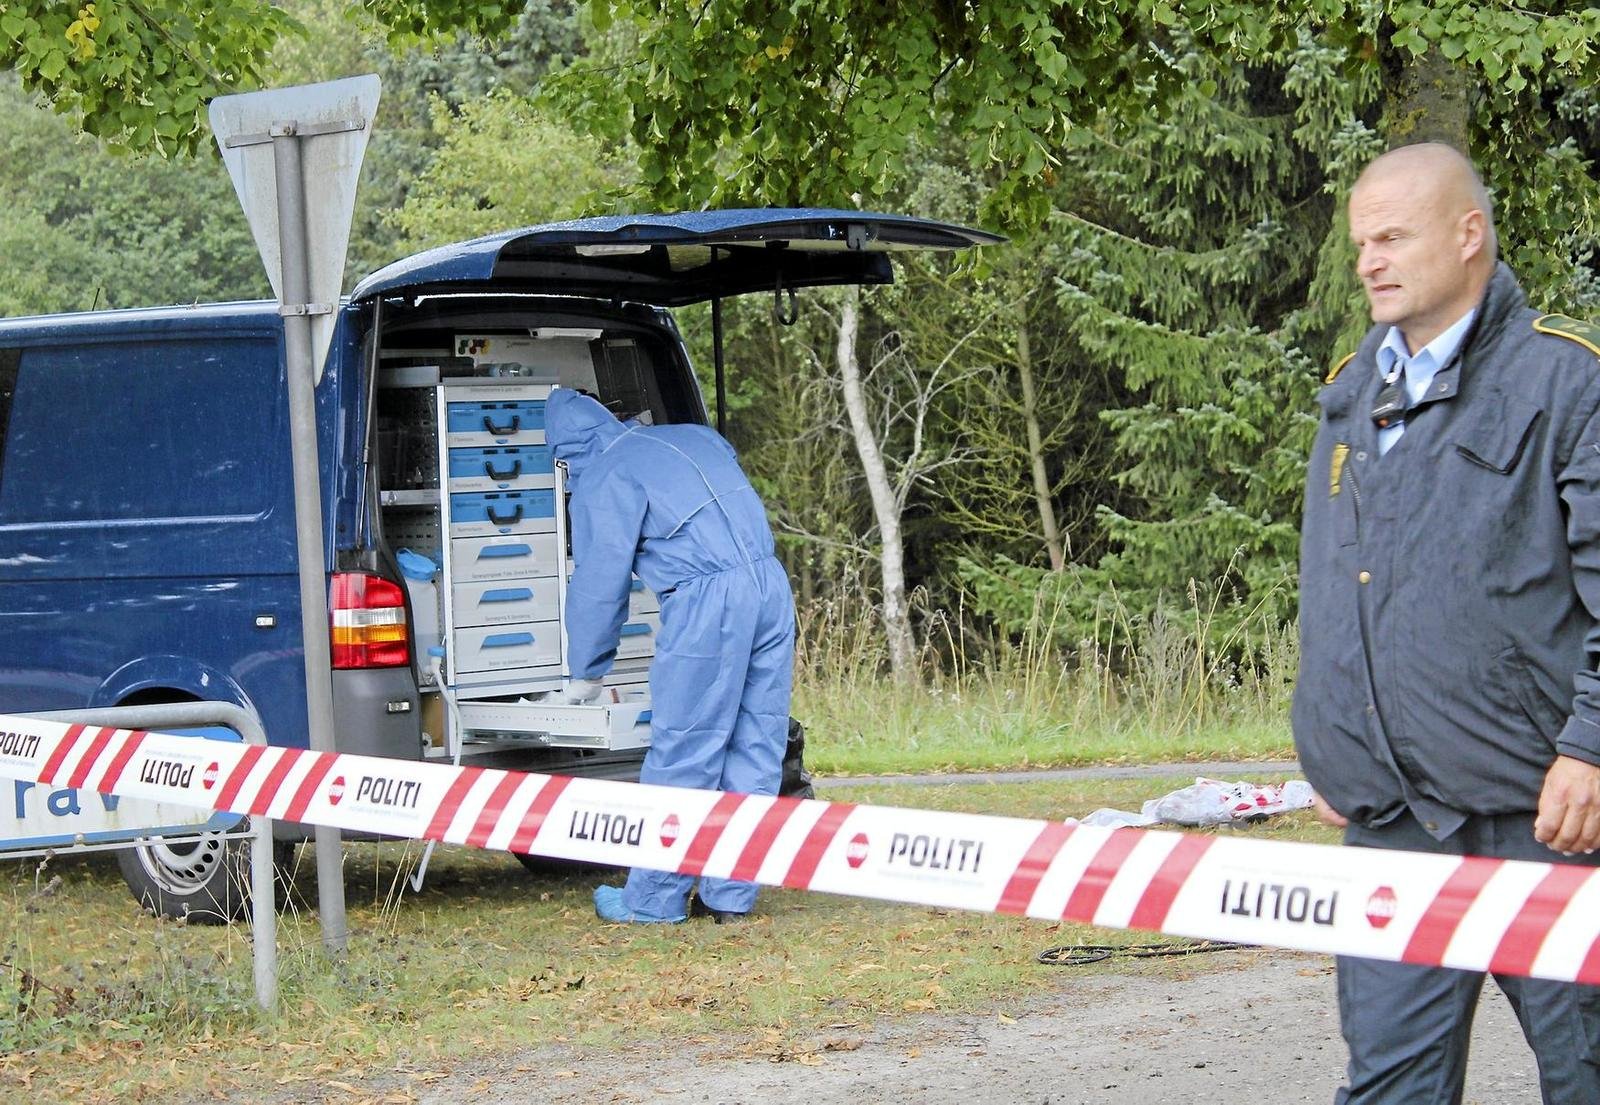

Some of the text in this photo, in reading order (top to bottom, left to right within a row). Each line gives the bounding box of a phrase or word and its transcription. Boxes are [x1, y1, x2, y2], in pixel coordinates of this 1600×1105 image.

[140, 759, 195, 789] POLITI
[356, 776, 422, 808] POLITI
[569, 810, 645, 846] POLITI
[888, 832, 984, 873] POLITI
[1221, 879, 1340, 926] POLITI
